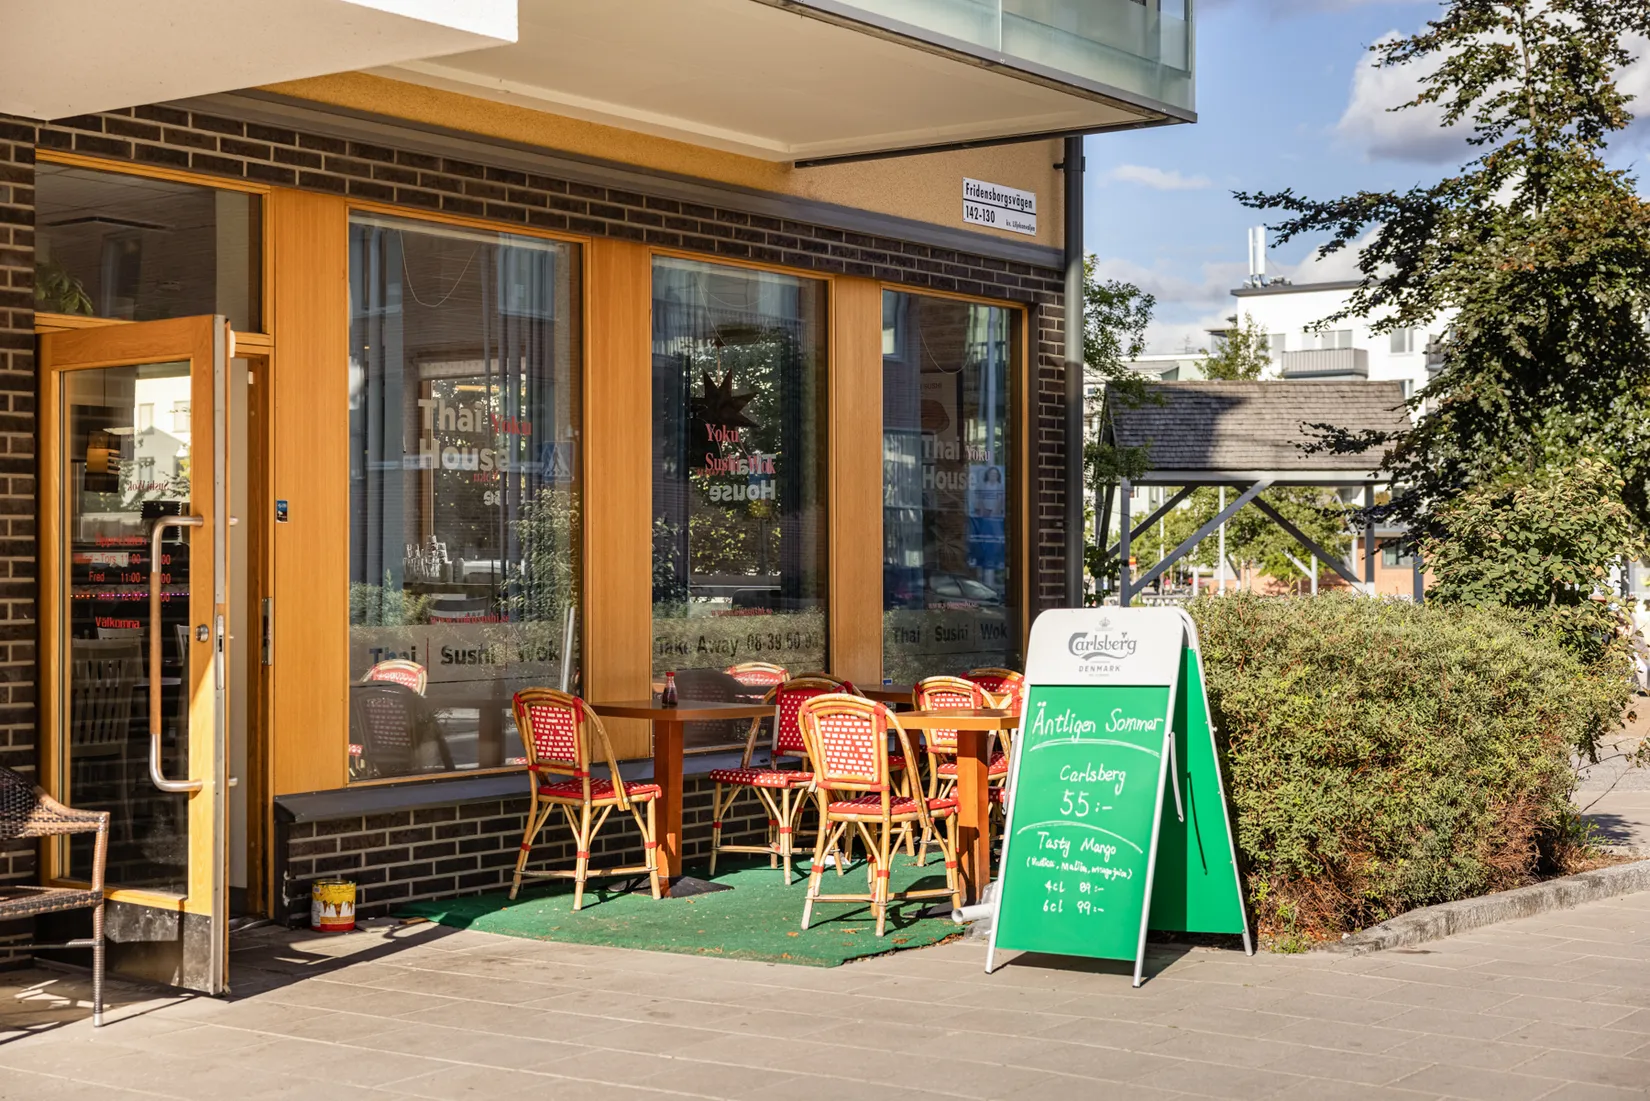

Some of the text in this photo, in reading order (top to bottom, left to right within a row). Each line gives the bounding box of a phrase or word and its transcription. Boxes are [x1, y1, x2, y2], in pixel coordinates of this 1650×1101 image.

[965, 182, 1033, 211] Fridensborgsvägen
[966, 205, 996, 223] 142-130
[418, 398, 482, 433] Thai
[490, 412, 532, 436] Yoku
[705, 423, 740, 443] Yoku
[419, 437, 511, 472] House
[922, 436, 961, 460] Thai
[965, 445, 991, 461] Yoku
[705, 452, 741, 472] Sushi
[747, 455, 777, 475] Wok
[922, 465, 978, 491] House
[101, 552, 116, 564] Tors
[89, 570, 105, 582] Fred
[120, 572, 141, 583] 11:00
[95, 616, 140, 629] Välkomna
[893, 622, 1008, 644] Thai Sushi Wok
[440, 643, 497, 665] Sushi
[697, 635, 739, 657] Away
[1068, 631, 1138, 658] Carlsberg
[1078, 665, 1121, 673] DENMARK
[1032, 701, 1096, 743] Äntligen
[1059, 763, 1127, 796] Carlsberg
[1037, 831, 1117, 863] Tasty Mango
